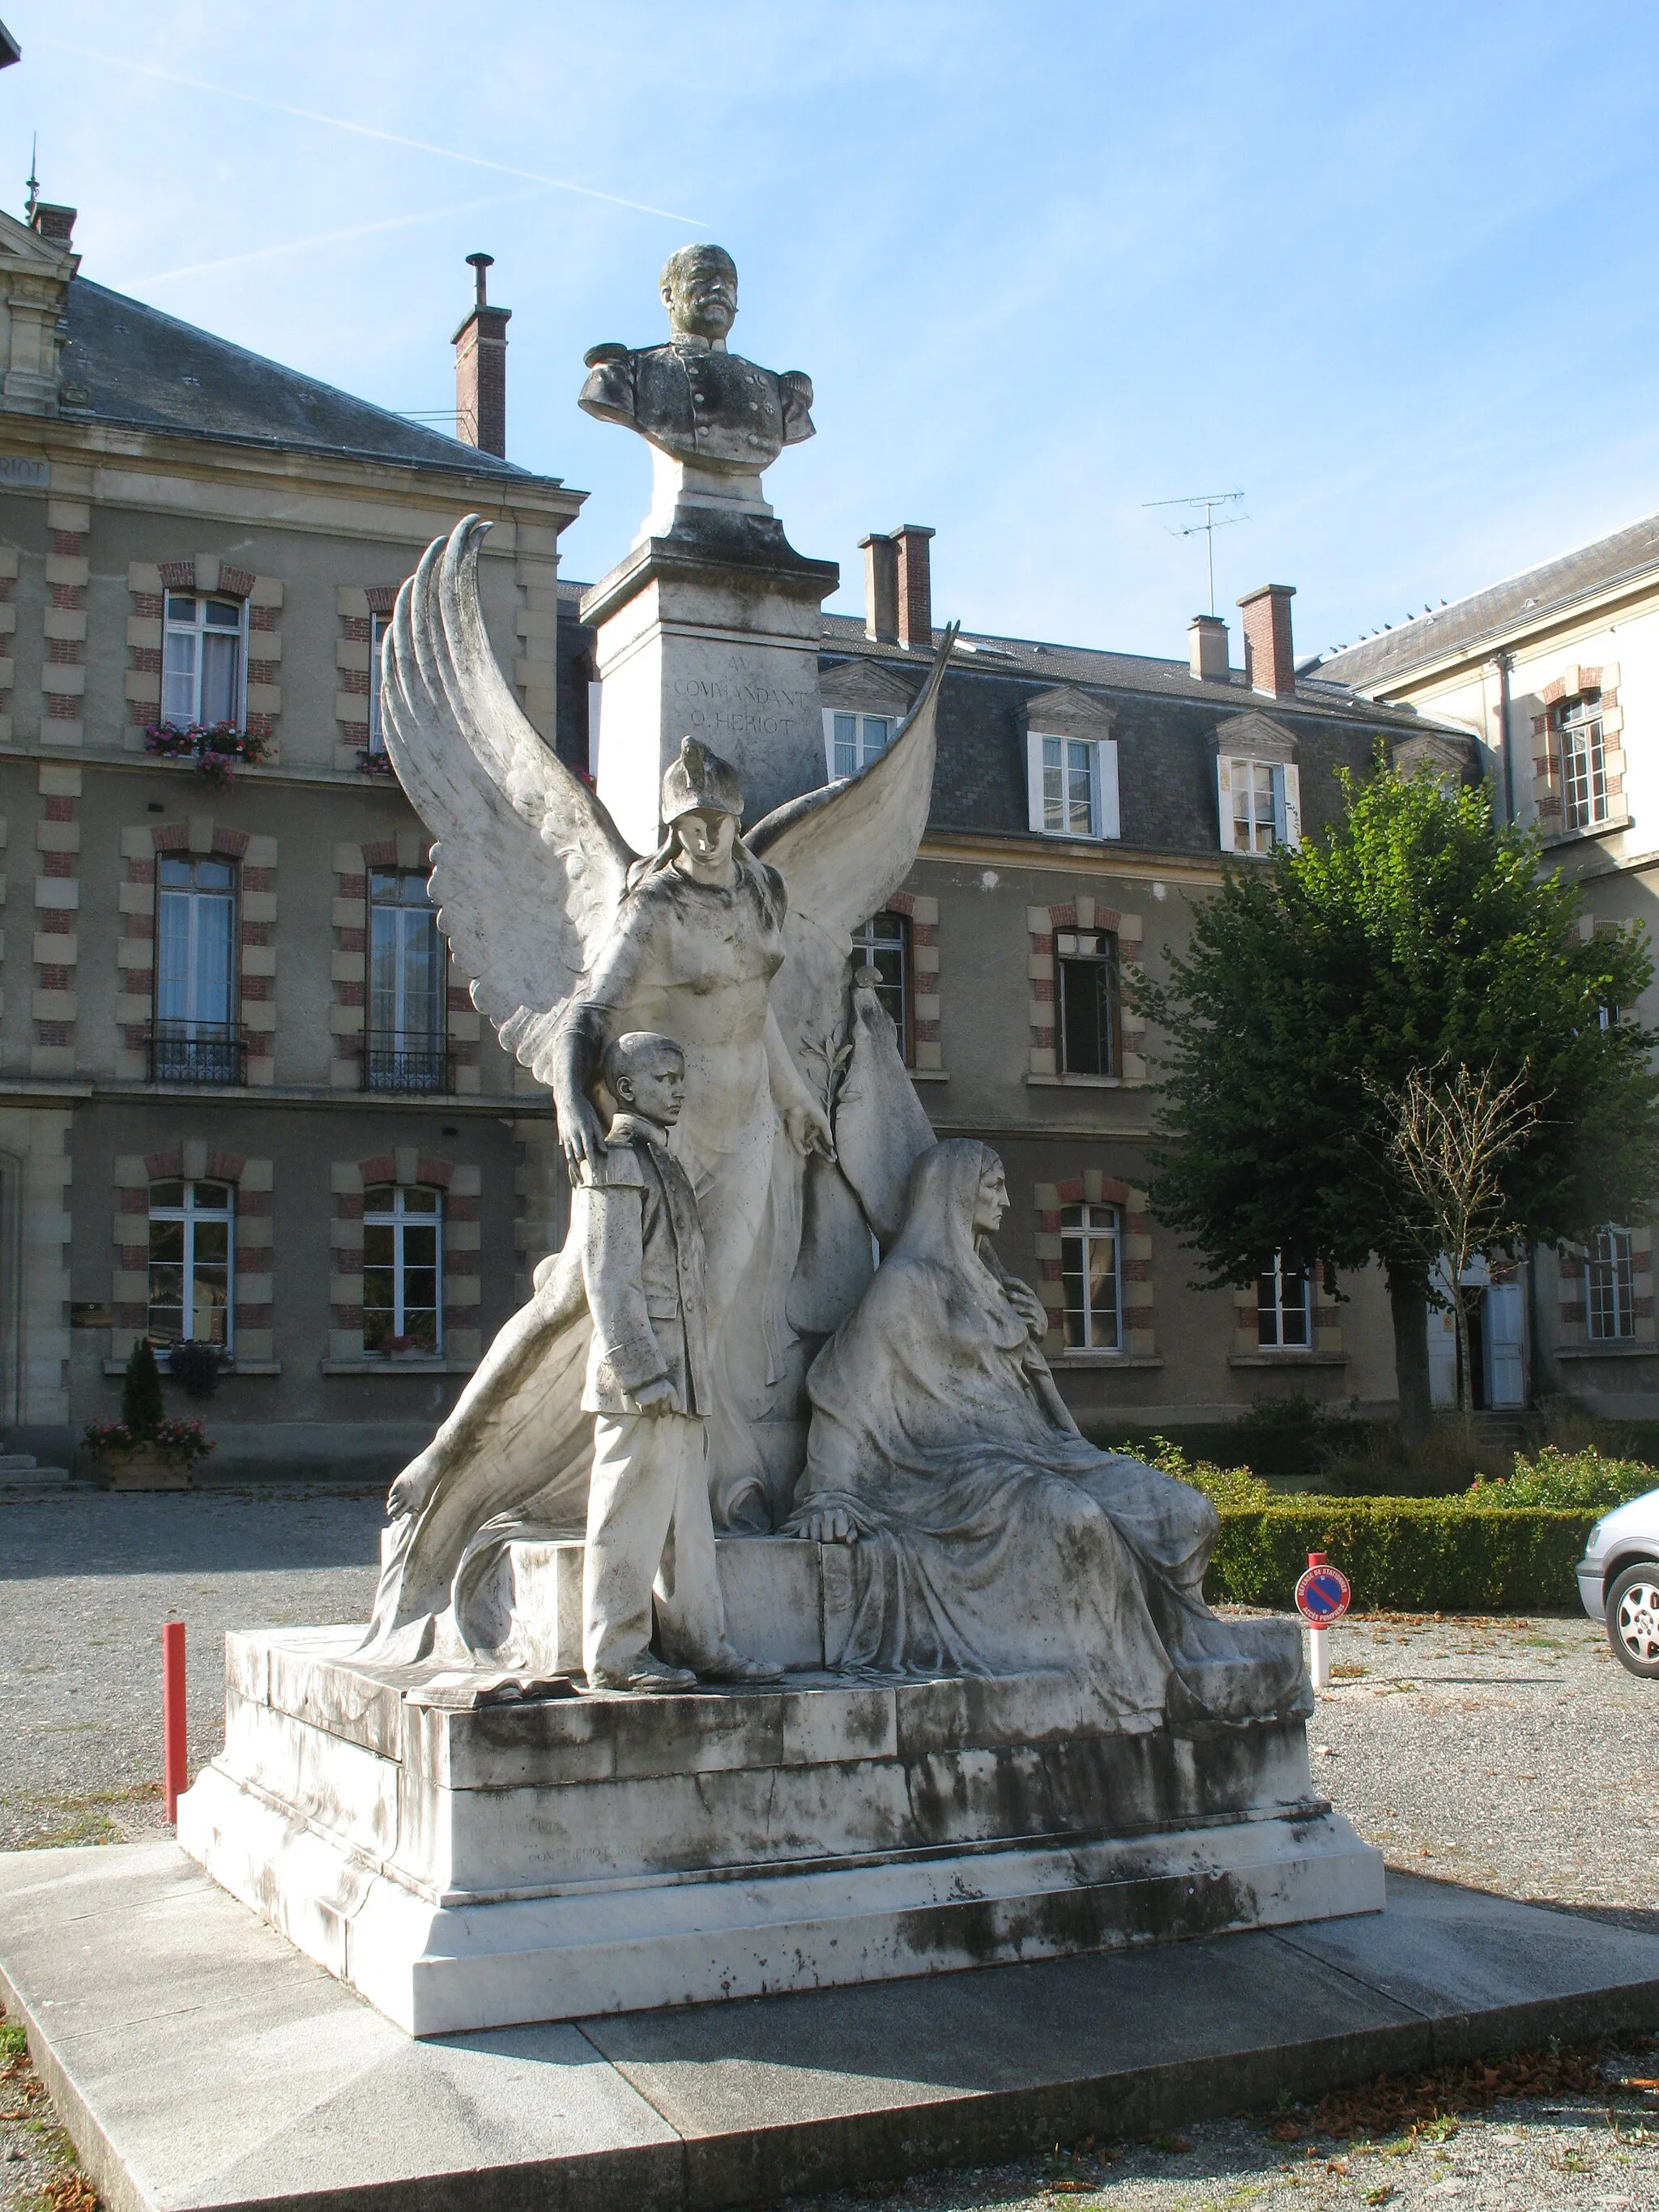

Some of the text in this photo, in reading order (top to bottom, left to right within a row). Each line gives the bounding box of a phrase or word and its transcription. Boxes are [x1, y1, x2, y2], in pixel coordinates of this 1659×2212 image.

[674, 678, 808, 710] COMMANDANT
[715, 712, 794, 735] HERIOT
[1314, 1568, 1322, 1576] DE
[1319, 1604, 1345, 1622] POMPIERS
